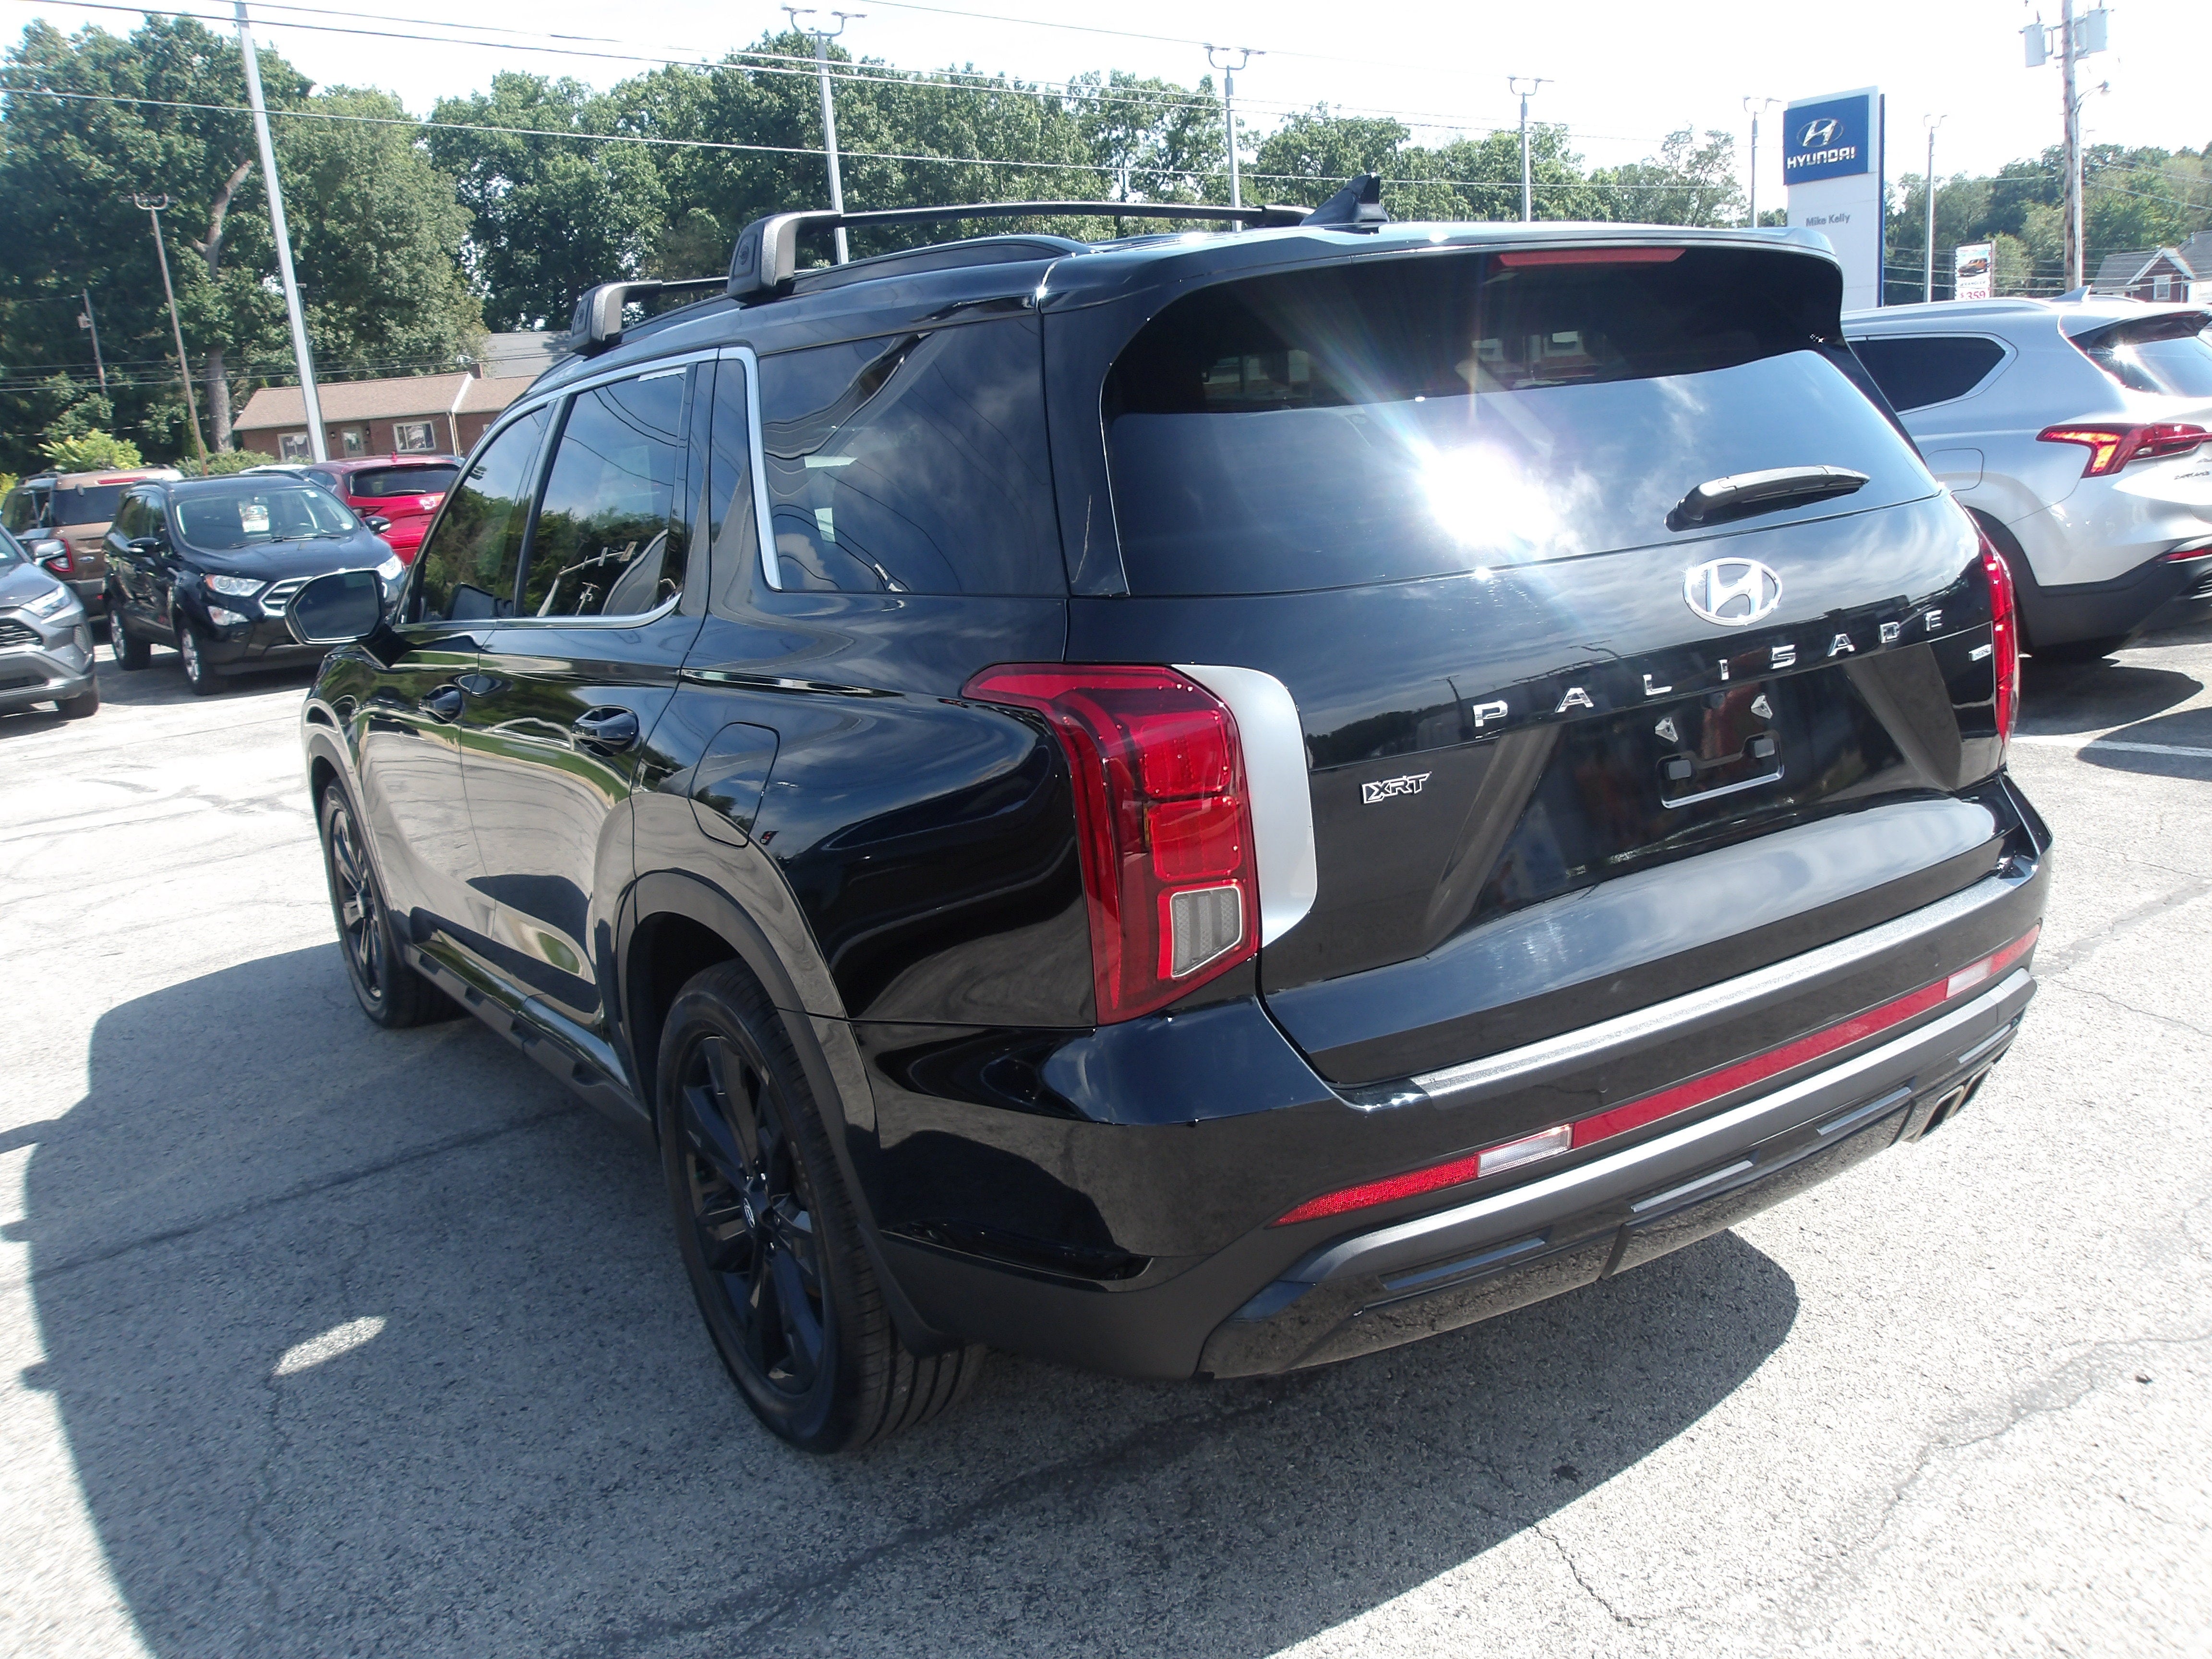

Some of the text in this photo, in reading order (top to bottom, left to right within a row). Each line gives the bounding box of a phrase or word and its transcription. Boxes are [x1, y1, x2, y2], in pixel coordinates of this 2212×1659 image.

[1787, 146, 1856, 169] HYUNDAI
[1805, 213, 1851, 227] Mike Kelly
[1473, 609, 1943, 728] PALISADE
[1362, 771, 1432, 804] XRT
